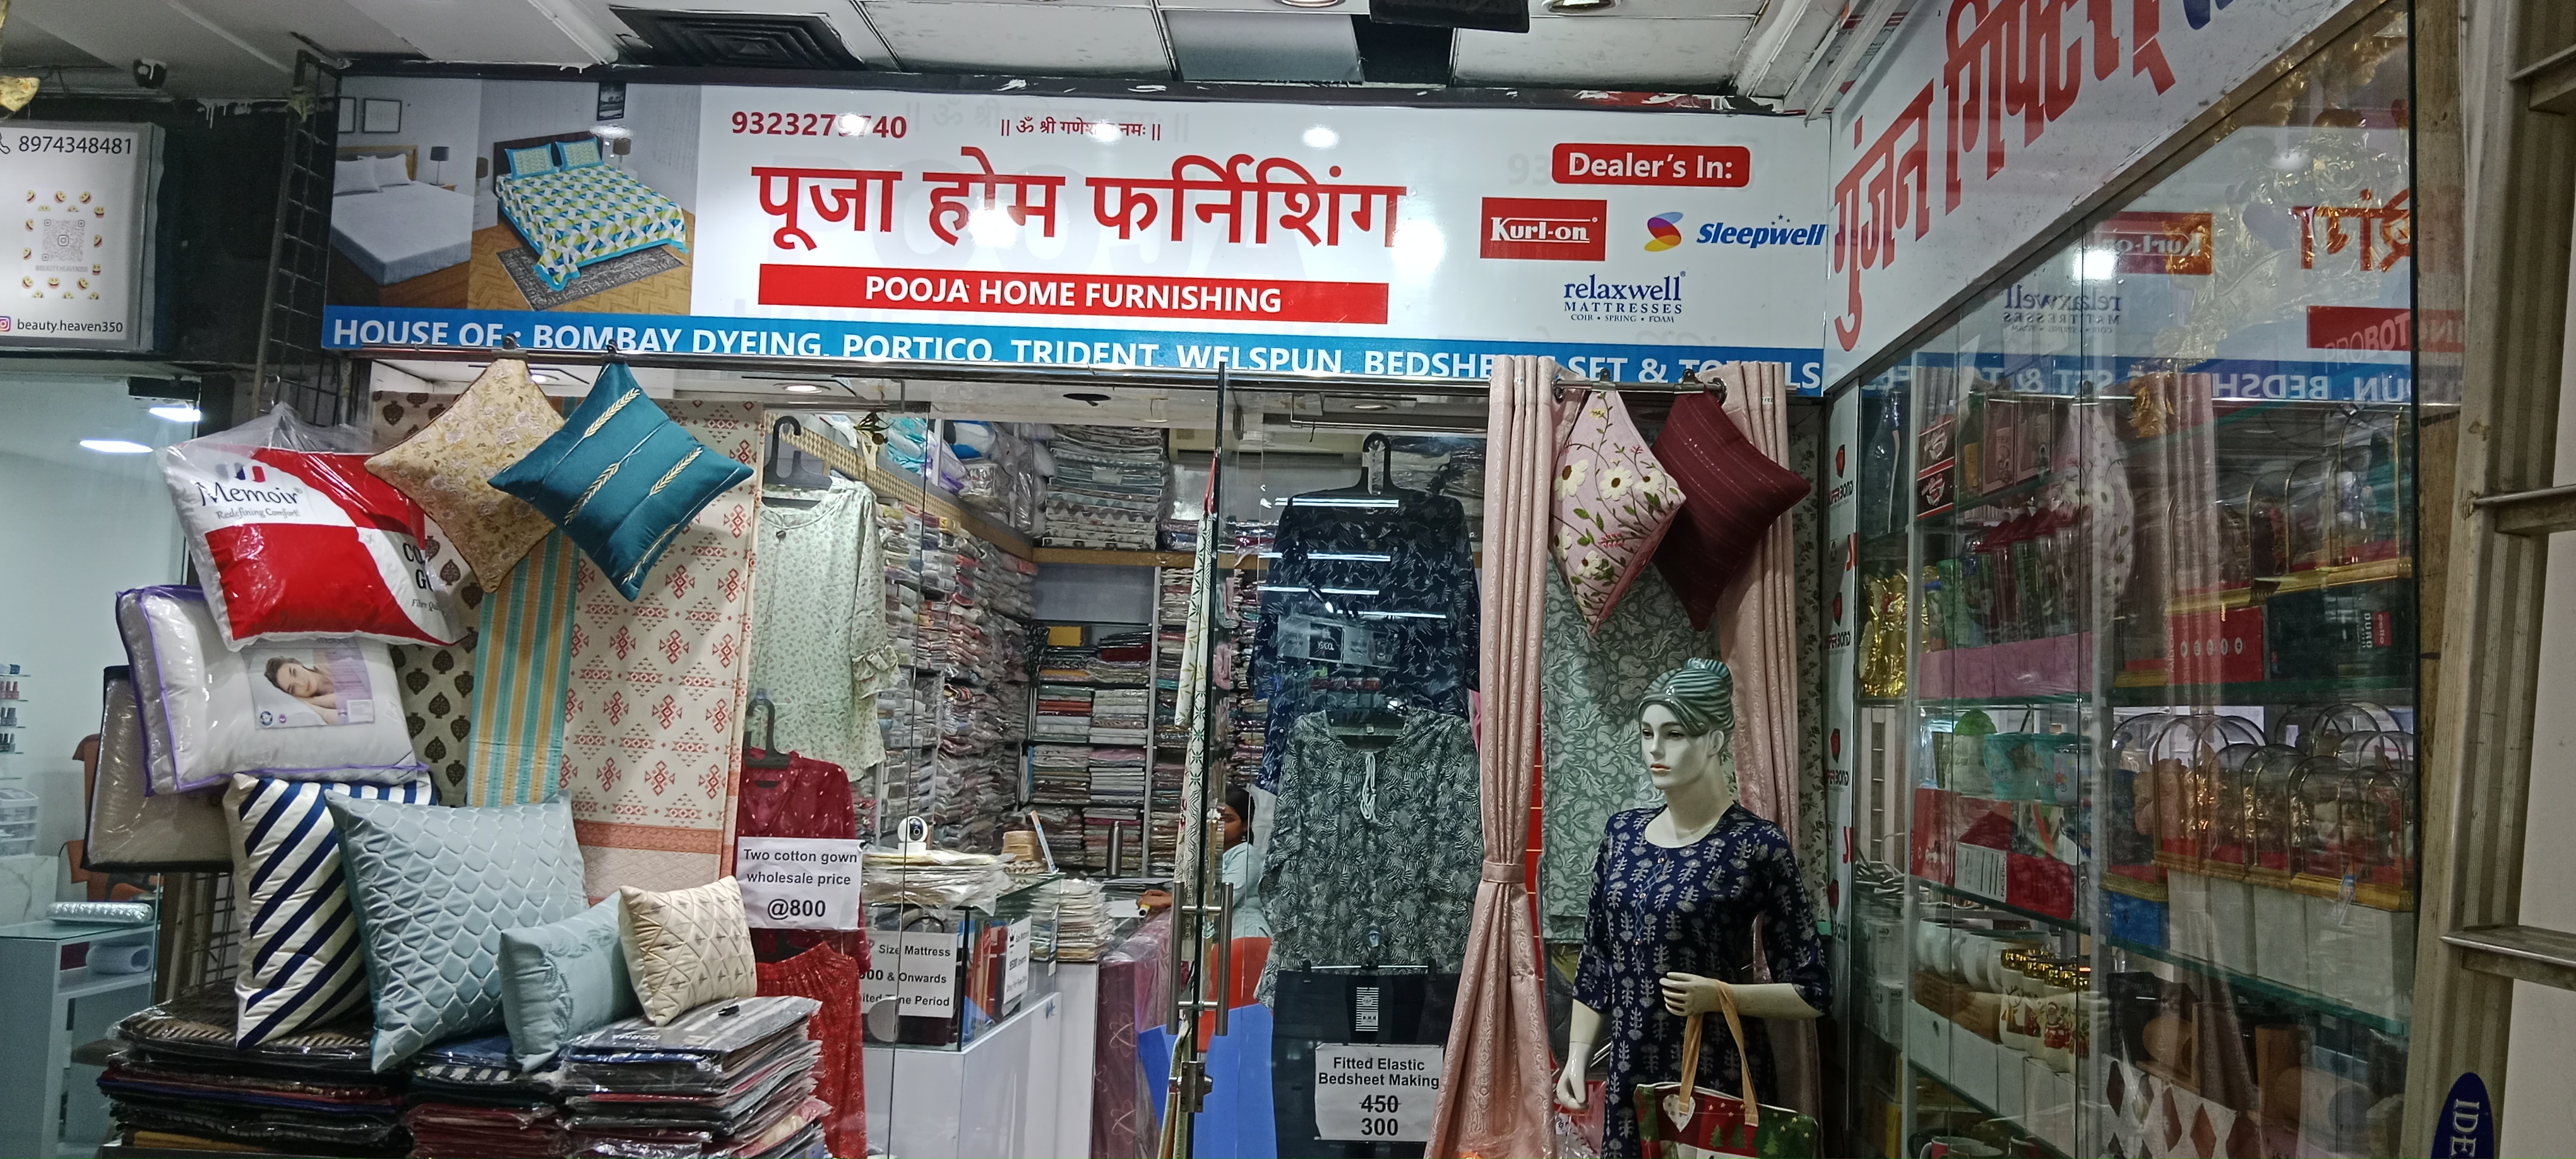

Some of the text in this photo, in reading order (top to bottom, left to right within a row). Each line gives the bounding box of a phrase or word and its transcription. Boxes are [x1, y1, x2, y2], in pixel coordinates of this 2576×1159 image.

[732, 111, 907, 139] 93232740
[1039, 116, 1056, 134] श्री
[19, 135, 131, 155] 8974348481
[1569, 152, 1686, 179] Dealer's
[1696, 155, 1732, 179] In:
[751, 146, 1407, 251] पूजा होम फर्निशिंग
[1490, 217, 1592, 244] Kurl-on
[1696, 223, 1827, 249] Sleepwell
[865, 275, 1282, 314] POOJA HOME FURNISHING
[1563, 273, 1682, 301] relaxwell
[1564, 302, 1683, 314] MATTRESSES
[17, 318, 124, 333] beauty.heaven350
[1604, 314, 1637, 323] SPRING
[1649, 315, 1674, 323] FOAM
[333, 319, 448, 347] HOUSE
[459, 323, 503, 347] OF
[534, 324, 682, 353] BOMBAY
[1638, 358, 1669, 383] &
[194, 482, 299, 506] Memoir
[216, 507, 265, 520] Redefining
[743, 848, 857, 865] Two cotton gown
[746, 871, 851, 887] wholesale price
[767, 898, 826, 920] @800
[904, 945, 951, 957] Mattress
[887, 972, 895, 982] &
[899, 972, 947, 984] Onwards
[915, 996, 950, 1006] Period
[1333, 1057, 1426, 1071] Fitted Elastic
[1318, 1072, 1440, 1090] Bedsheet Making
[1360, 1095, 1400, 1113] 450
[1361, 1117, 1399, 1136] 300
